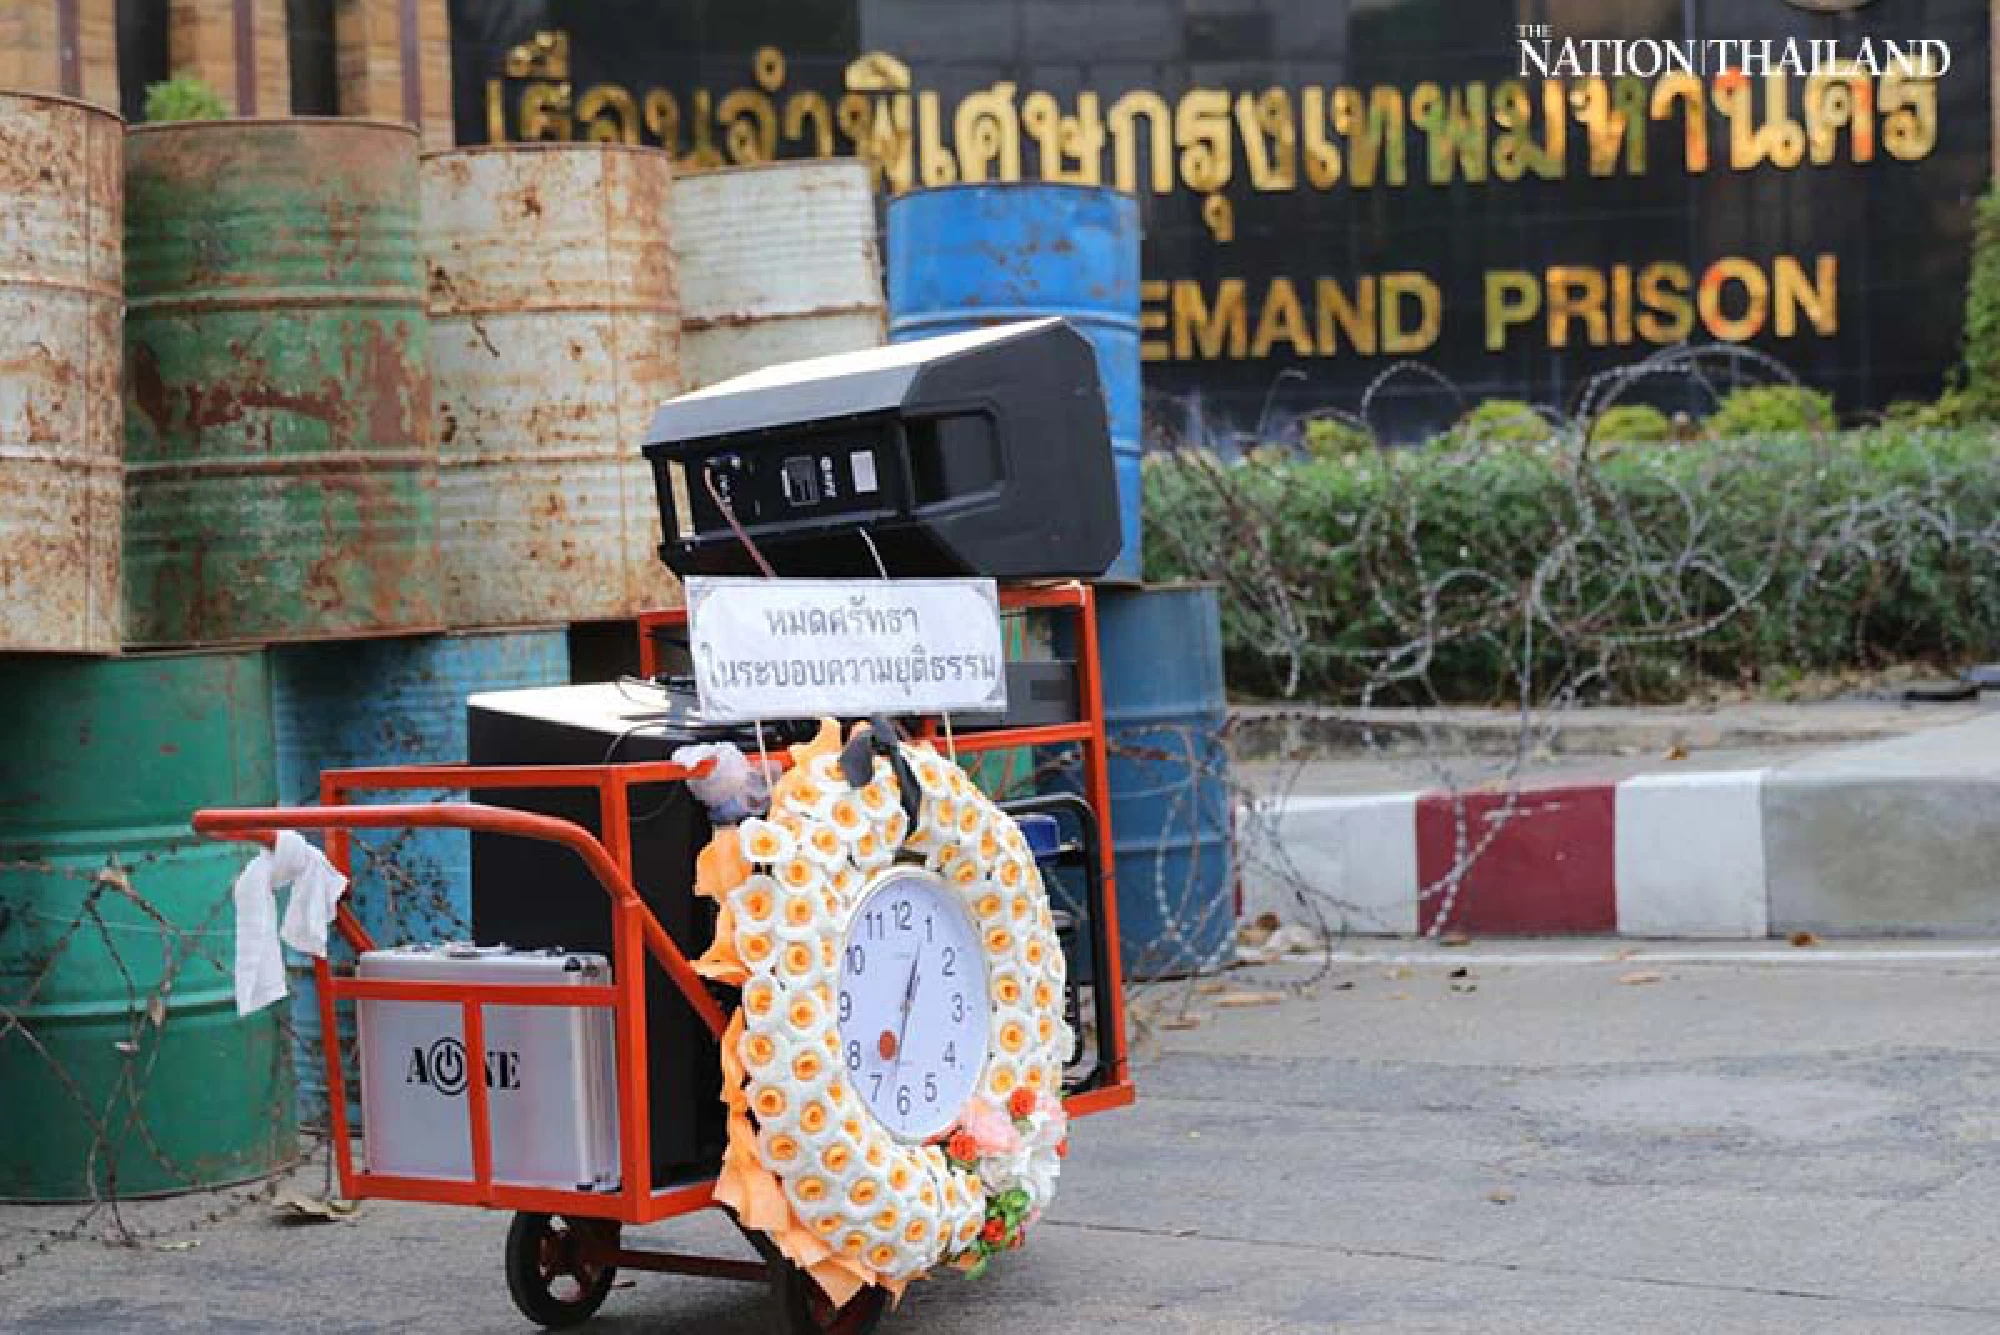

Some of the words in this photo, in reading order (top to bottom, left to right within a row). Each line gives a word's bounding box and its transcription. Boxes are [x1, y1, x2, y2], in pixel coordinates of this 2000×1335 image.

[1484, 253, 1839, 351] PRISON
[763, 594, 920, 636] หมดศรัทธา
[700, 640, 997, 696] ในระบอบความยุติธรรม
[865, 911, 883, 940] 11
[891, 900, 912, 931] 12
[925, 915, 933, 942] 1
[846, 944, 866, 975] 10
[942, 946, 956, 977] 2
[839, 991, 852, 1023] 9
[951, 992, 963, 1022] 3
[847, 1040, 861, 1071] 8
[942, 1040, 956, 1069] 4
[870, 1072, 882, 1102] 7
[897, 1085, 911, 1116] 6
[925, 1072, 938, 1102] 5
